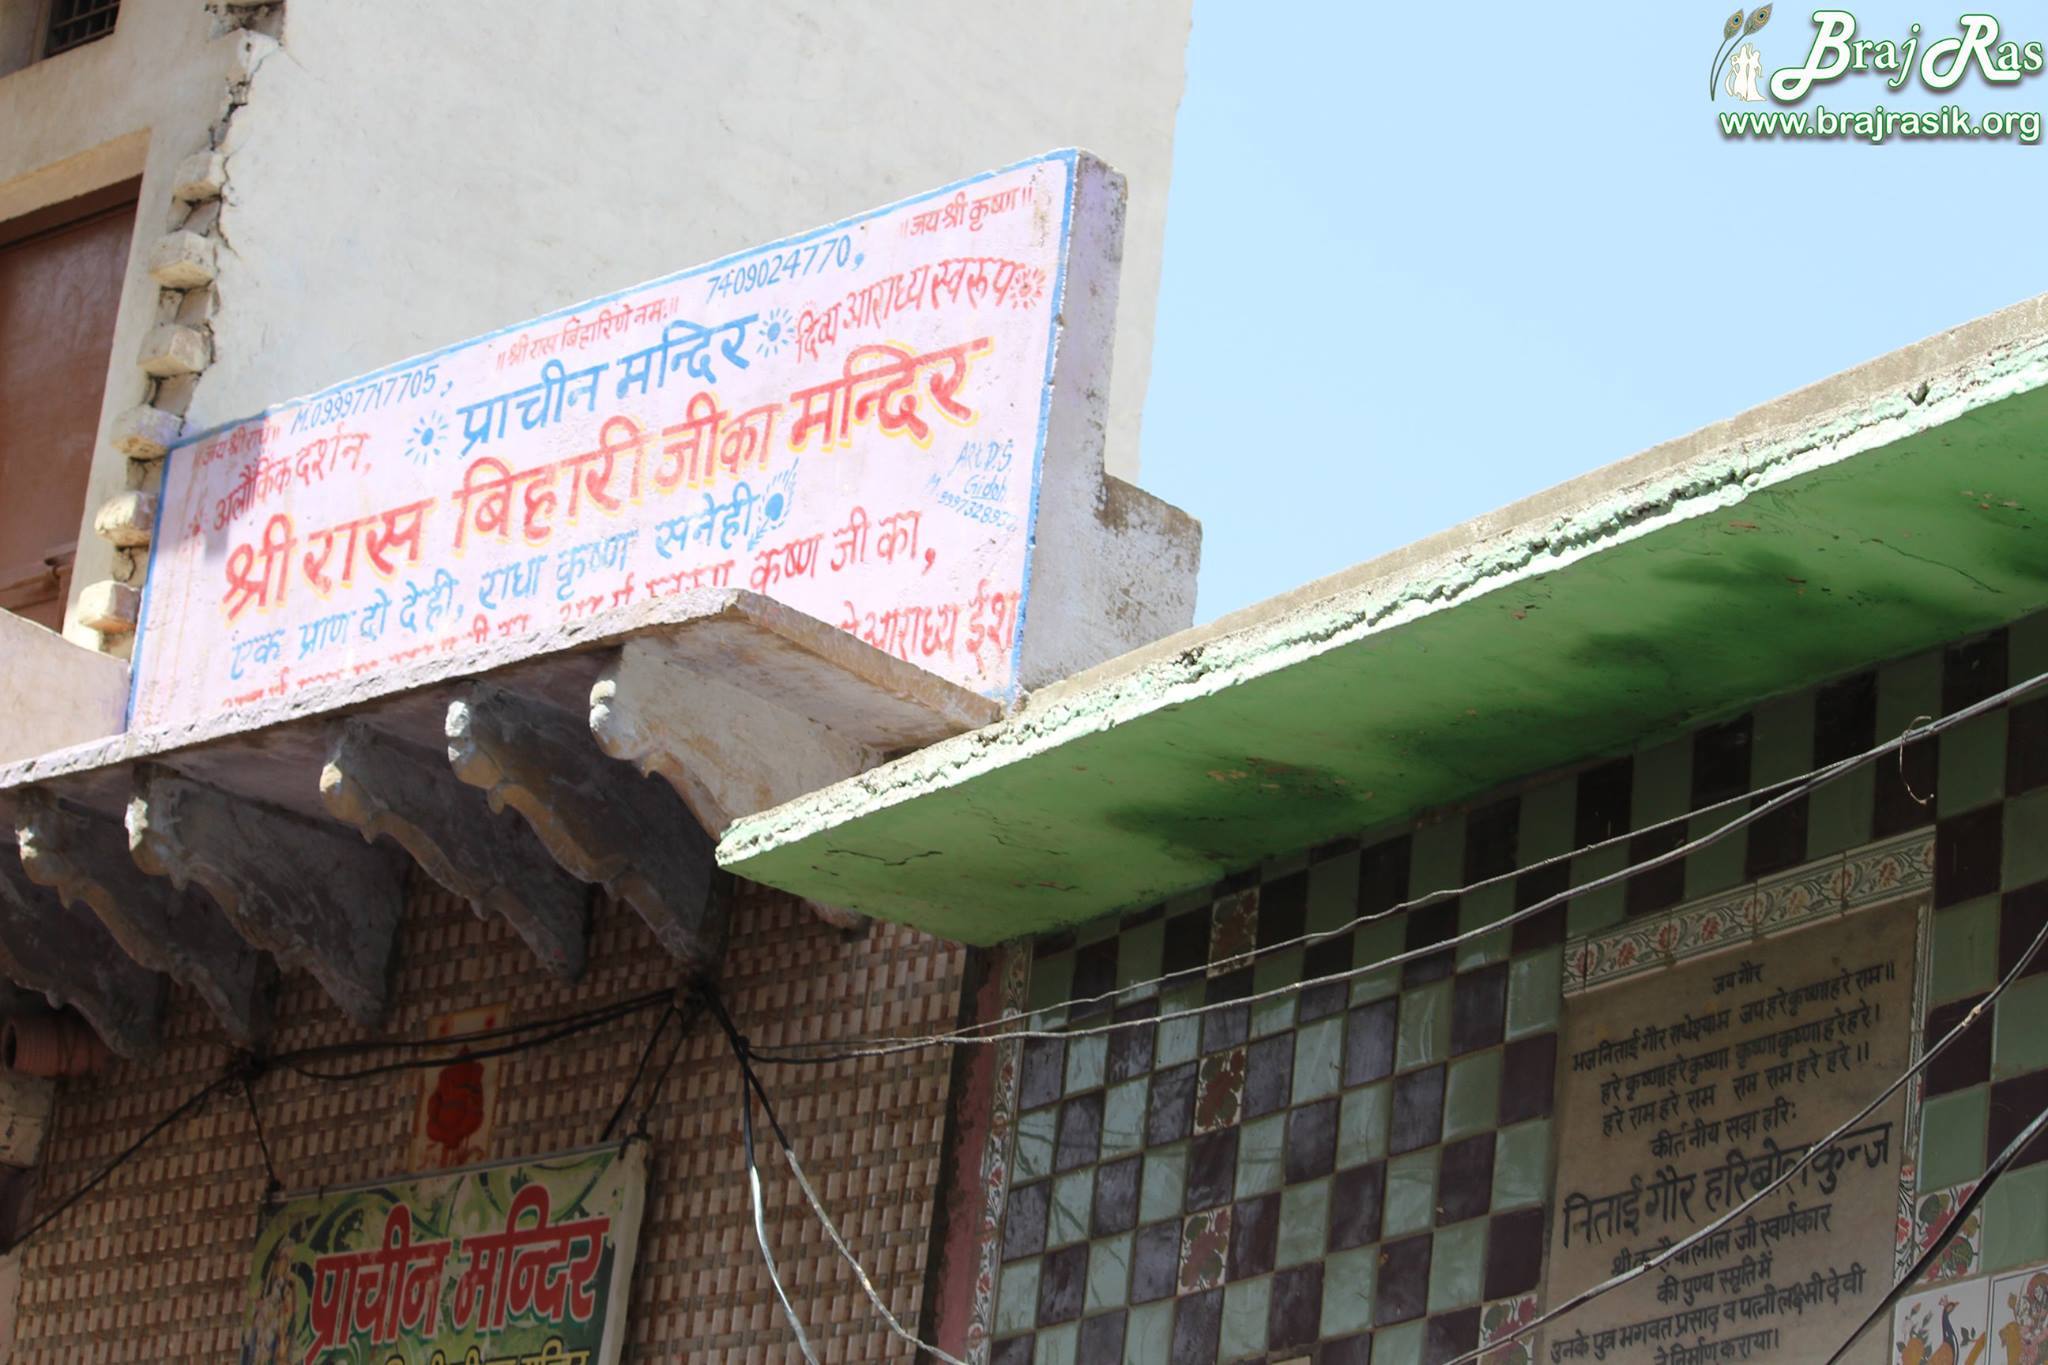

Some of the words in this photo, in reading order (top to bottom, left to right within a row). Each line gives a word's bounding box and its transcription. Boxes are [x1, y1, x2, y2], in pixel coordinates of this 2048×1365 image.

[942, 191, 968, 229] श्री
[456, 359, 610, 459] प्राचीन
[615, 313, 760, 400] मन्दिर
[220, 513, 298, 623] श्री
[303, 497, 437, 598] रास
[452, 415, 652, 552] बिहारी
[788, 337, 993, 449] मन्दिर
[750, 532, 823, 593] कष्ण
[830, 505, 870, 572] जी
[229, 629, 286, 681] एक
[298, 611, 356, 660] प्राण
[361, 588, 393, 641] दो
[478, 555, 548, 610] राधा
[1627, 1100, 1657, 1130] राम
[1685, 1083, 1717, 1114] राम
[1732, 1071, 1760, 1101] राम
[1562, 1173, 1643, 1248] निताई
[1644, 1163, 1697, 1224] गौर
[303, 1203, 450, 1365] प्राचीन
[453, 1184, 612, 1332] मन्दिर
[1656, 1275, 1681, 1305] की
